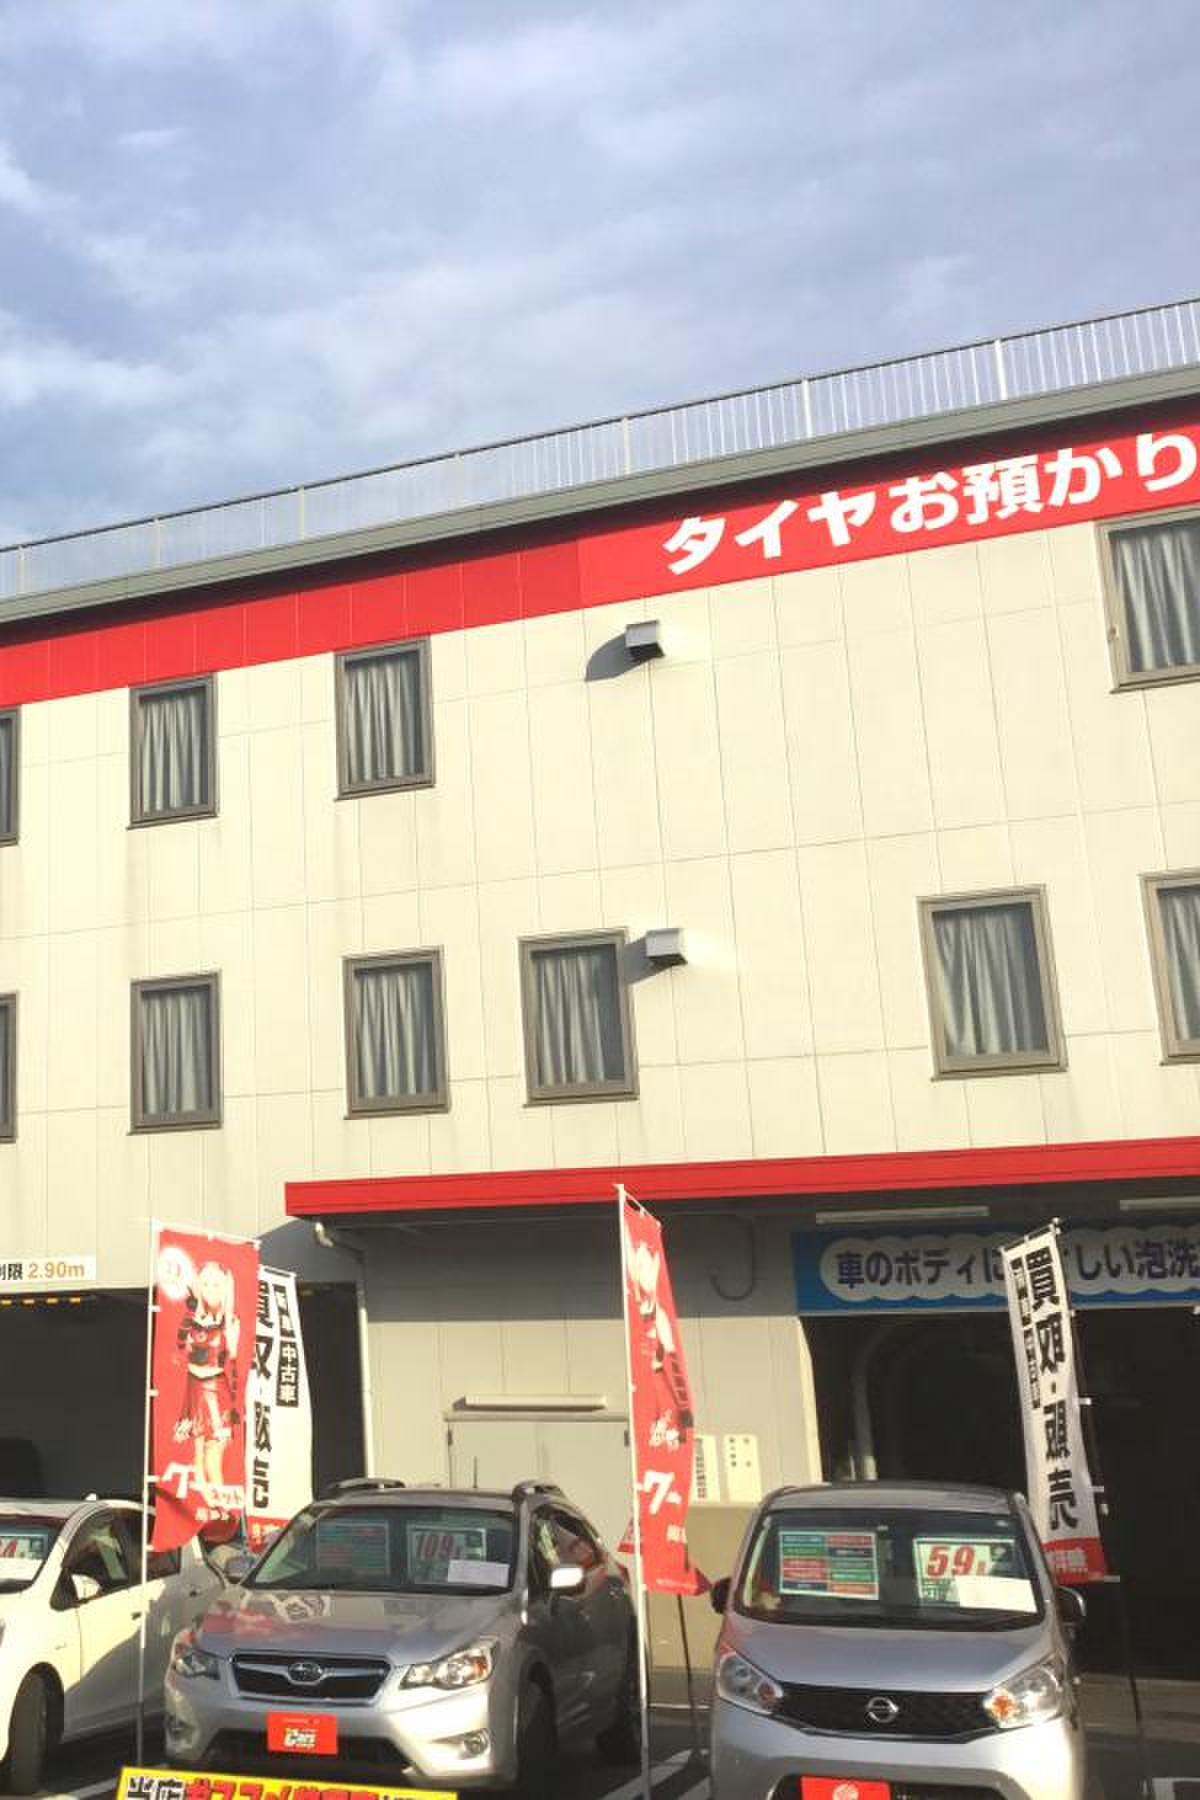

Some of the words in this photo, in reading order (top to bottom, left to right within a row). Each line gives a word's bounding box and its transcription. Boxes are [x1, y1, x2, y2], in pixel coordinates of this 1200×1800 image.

[663, 432, 1197, 575] タイヤお預かり
[26, 1260, 86, 1280] 2.90m
